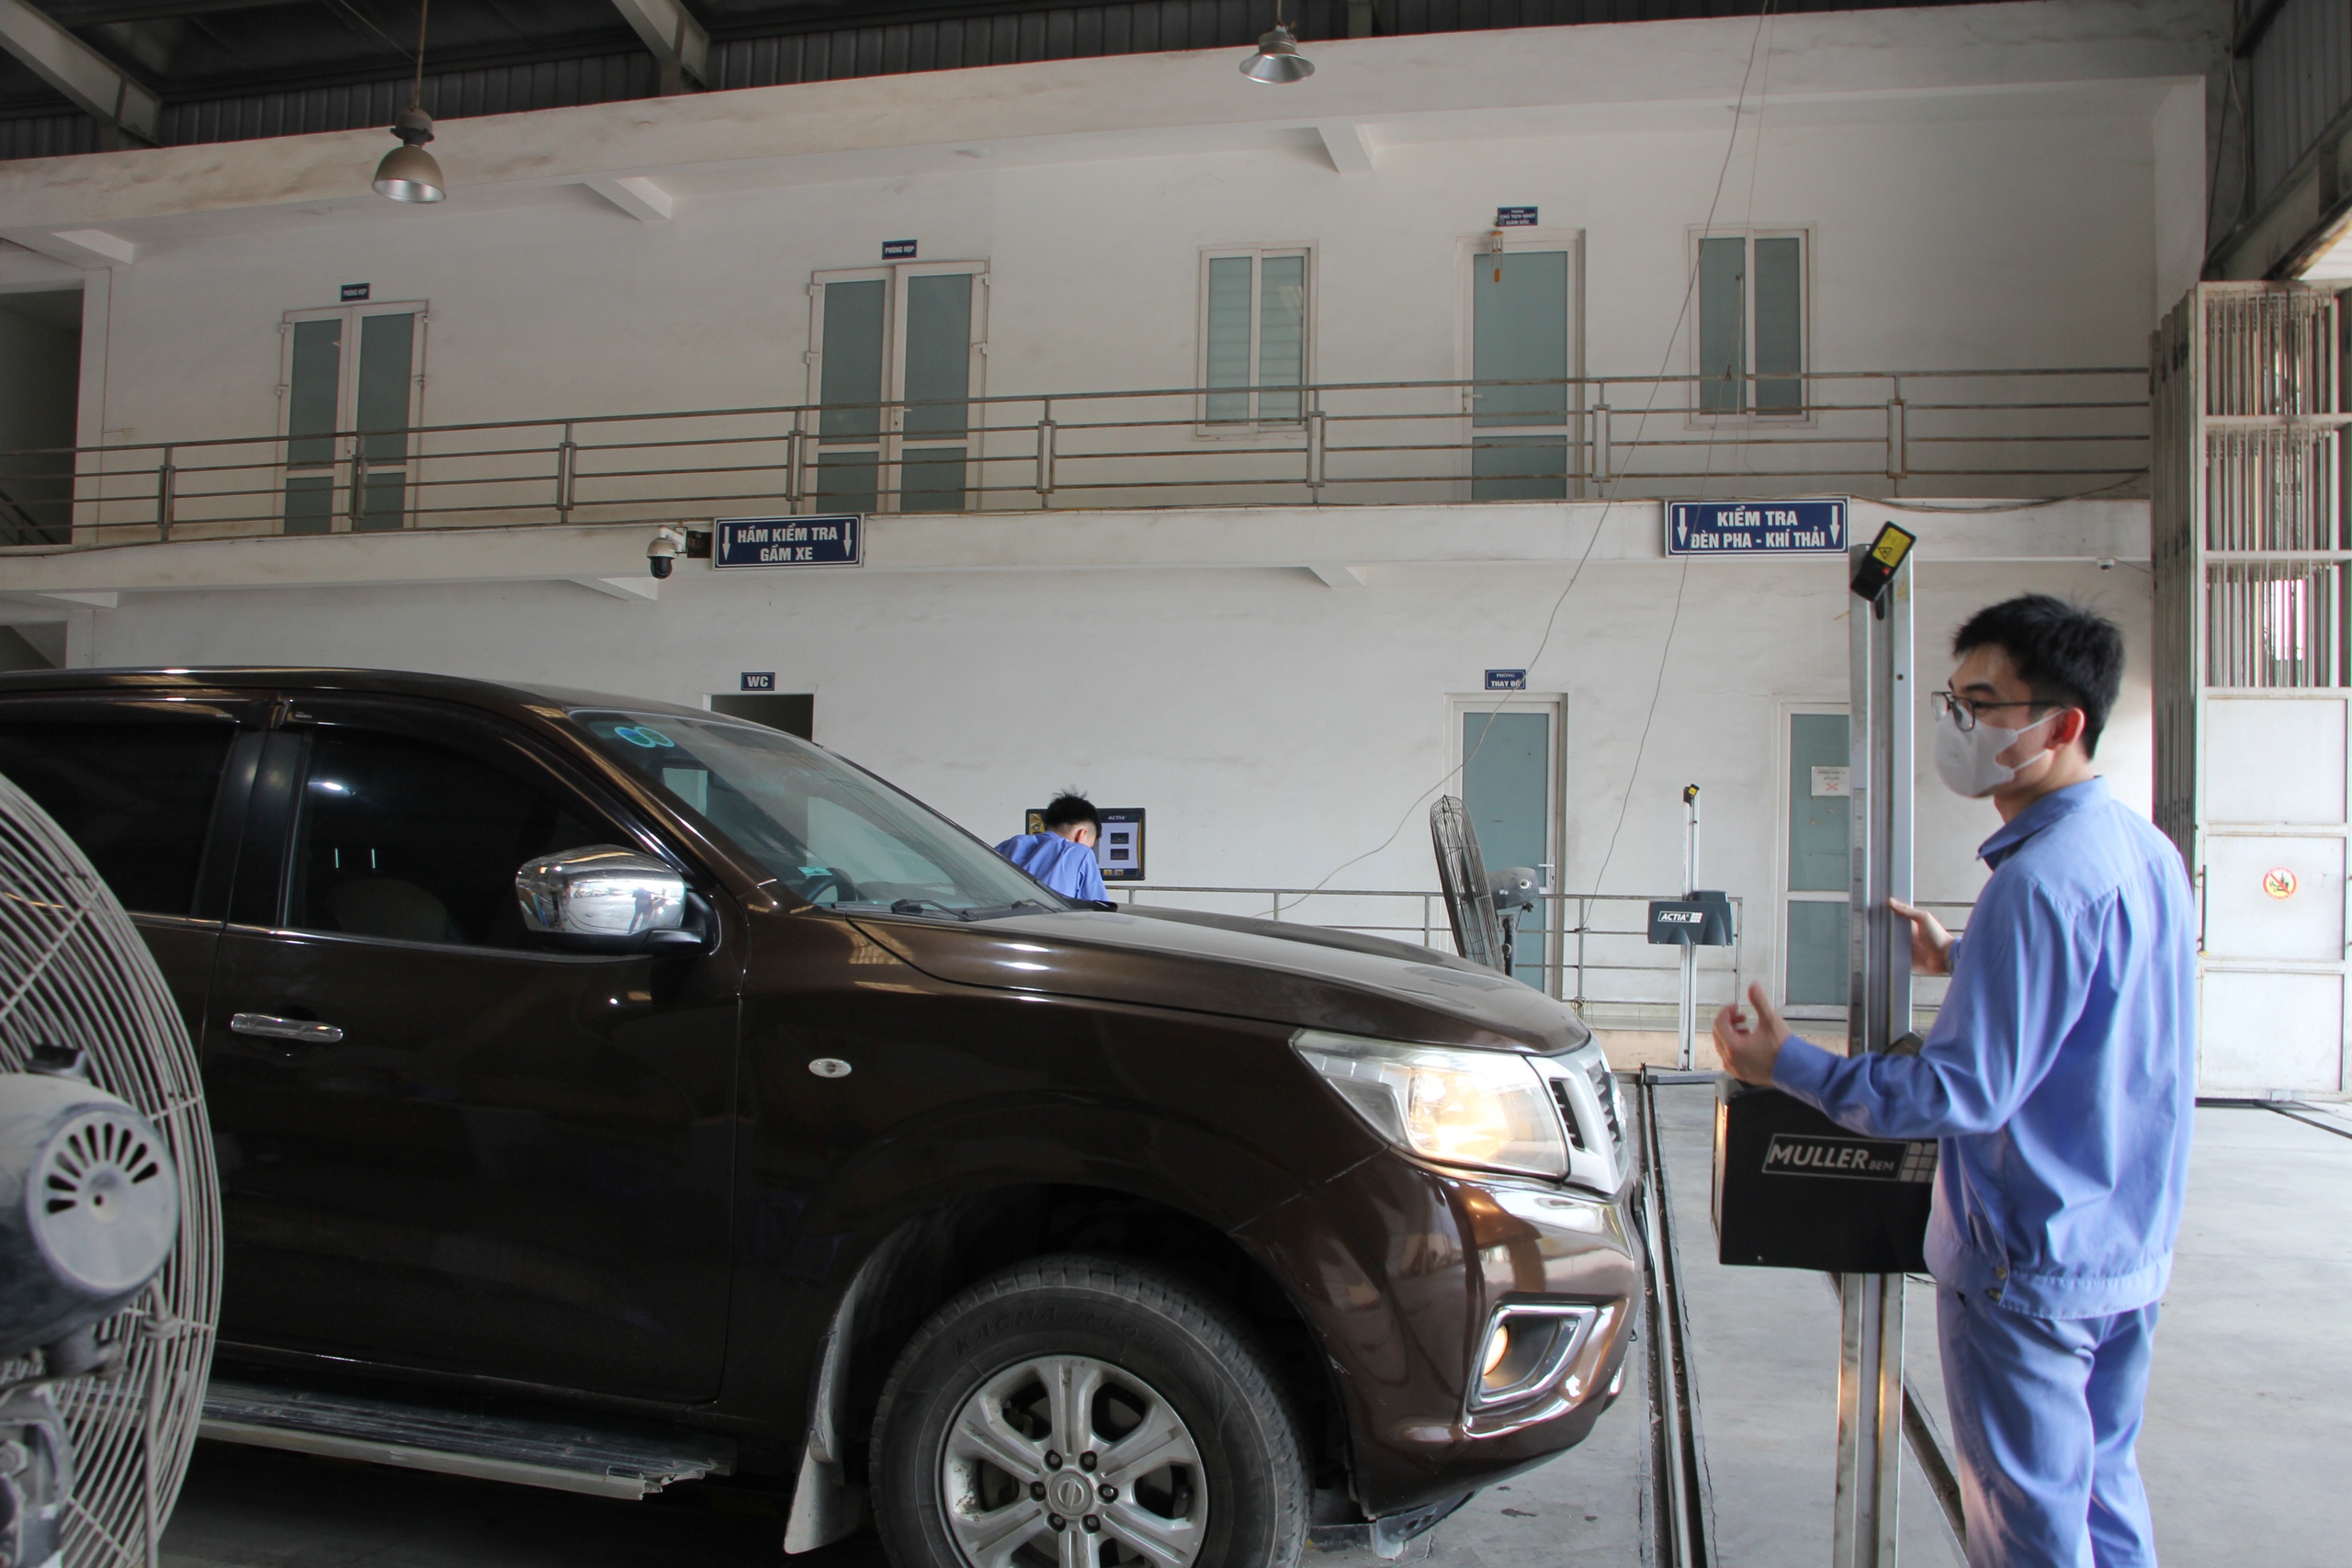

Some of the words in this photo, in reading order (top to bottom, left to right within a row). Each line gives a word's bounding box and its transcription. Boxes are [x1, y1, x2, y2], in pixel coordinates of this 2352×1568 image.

[1717, 505, 1760, 526] KIỂM
[1765, 510, 1798, 526] TRA
[737, 525, 769, 543] HẦM
[772, 523, 808, 542] KIỂM
[811, 526, 838, 541] TRA
[1690, 529, 1720, 549] ĐÈN
[1723, 533, 1752, 548] PHA
[1765, 528, 1791, 547] KHÍ
[1793, 525, 1826, 547] THẢI
[760, 543, 792, 562] GẦM
[795, 547, 813, 560] XE
[747, 675, 769, 688] WC
[1490, 680, 1510, 688] THAY
[1660, 912, 1688, 921] ACTIA
[1768, 1144, 1870, 1170] MULLER
[1869, 1159, 1895, 1172] BEM
